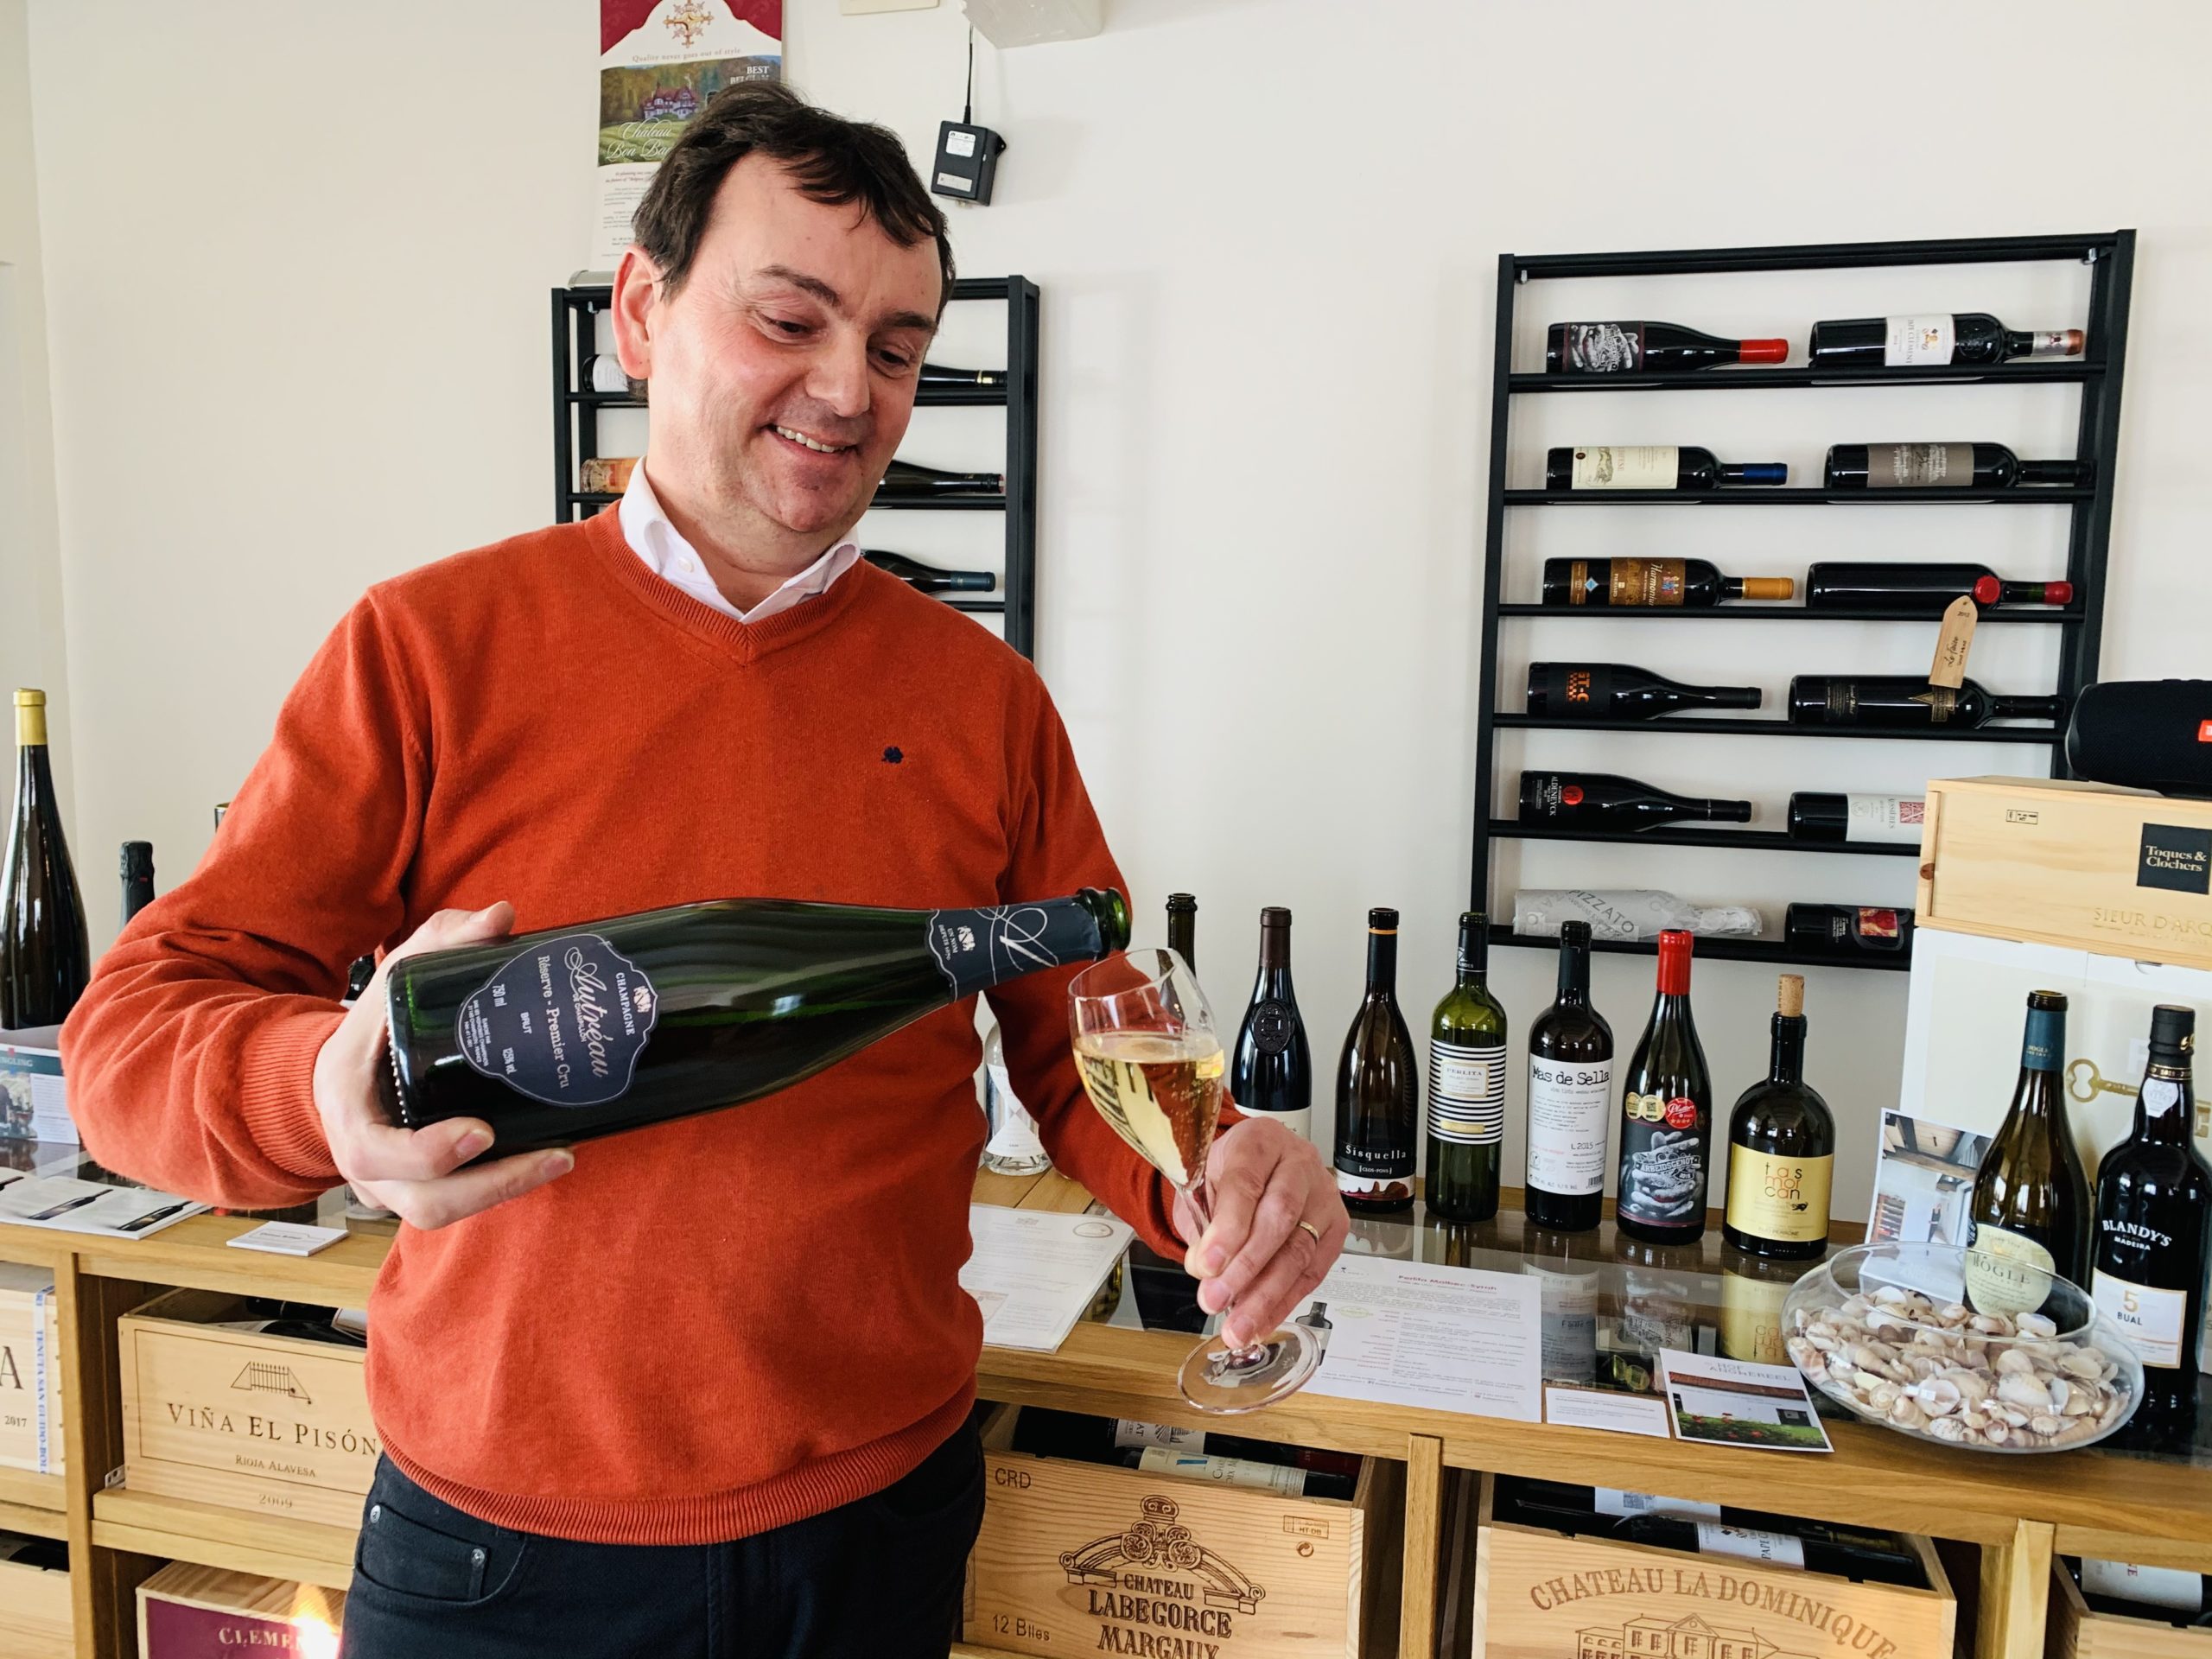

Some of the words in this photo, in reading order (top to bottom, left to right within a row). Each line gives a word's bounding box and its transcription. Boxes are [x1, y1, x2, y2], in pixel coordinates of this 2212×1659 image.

[747, 66, 770, 74] BEST
[606, 141, 636, 162] Bon
[1548, 776, 1558, 817] ALDENEYCK
[2145, 845, 2192, 860] Toques
[2194, 851, 2207, 862] &
[2145, 855, 2202, 872] Clochers
[2094, 907, 2146, 927] SIEUR
[493, 983, 505, 997] 750
[493, 997, 508, 1007] ml
[564, 946, 613, 1078] Autréau
[615, 972, 636, 1036] CHAMPAGNE
[520, 1011, 532, 1034] BRUT
[537, 955, 553, 998] Réserve
[546, 1007, 564, 1062] Premier
[556, 1064, 570, 1089] Cru
[1533, 1065, 1553, 1083] Mas
[1556, 1071, 1573, 1086] de
[1577, 1070, 1610, 1086] Sella
[1345, 1144, 1407, 1161] Sisquella
[2102, 1219, 2172, 1247] BLANDY'S
[2114, 1236, 2151, 1250] MADEIRA
[2123, 1290, 2139, 1304] 5
[2118, 1312, 2143, 1325] BUAL
[4, 1415, 28, 1427] 2017
[168, 1403, 234, 1433] VIÑA
[249, 1415, 281, 1441] EL
[296, 1423, 377, 1456] PISÓN
[236, 1454, 264, 1470] RIOJA
[269, 1460, 316, 1478] ALAVESA
[995, 1468, 1032, 1490] CRD
[259, 1494, 293, 1509] 2009
[1124, 1573, 1194, 1600] CHATEAU
[1088, 1588, 1232, 1638] LABEGORCE
[1530, 1567, 1664, 1611] CHATEAU
[1674, 1569, 1712, 1599] LA
[1718, 1574, 1899, 1658] DOMINIQUE
[992, 1614, 1009, 1633] 12
